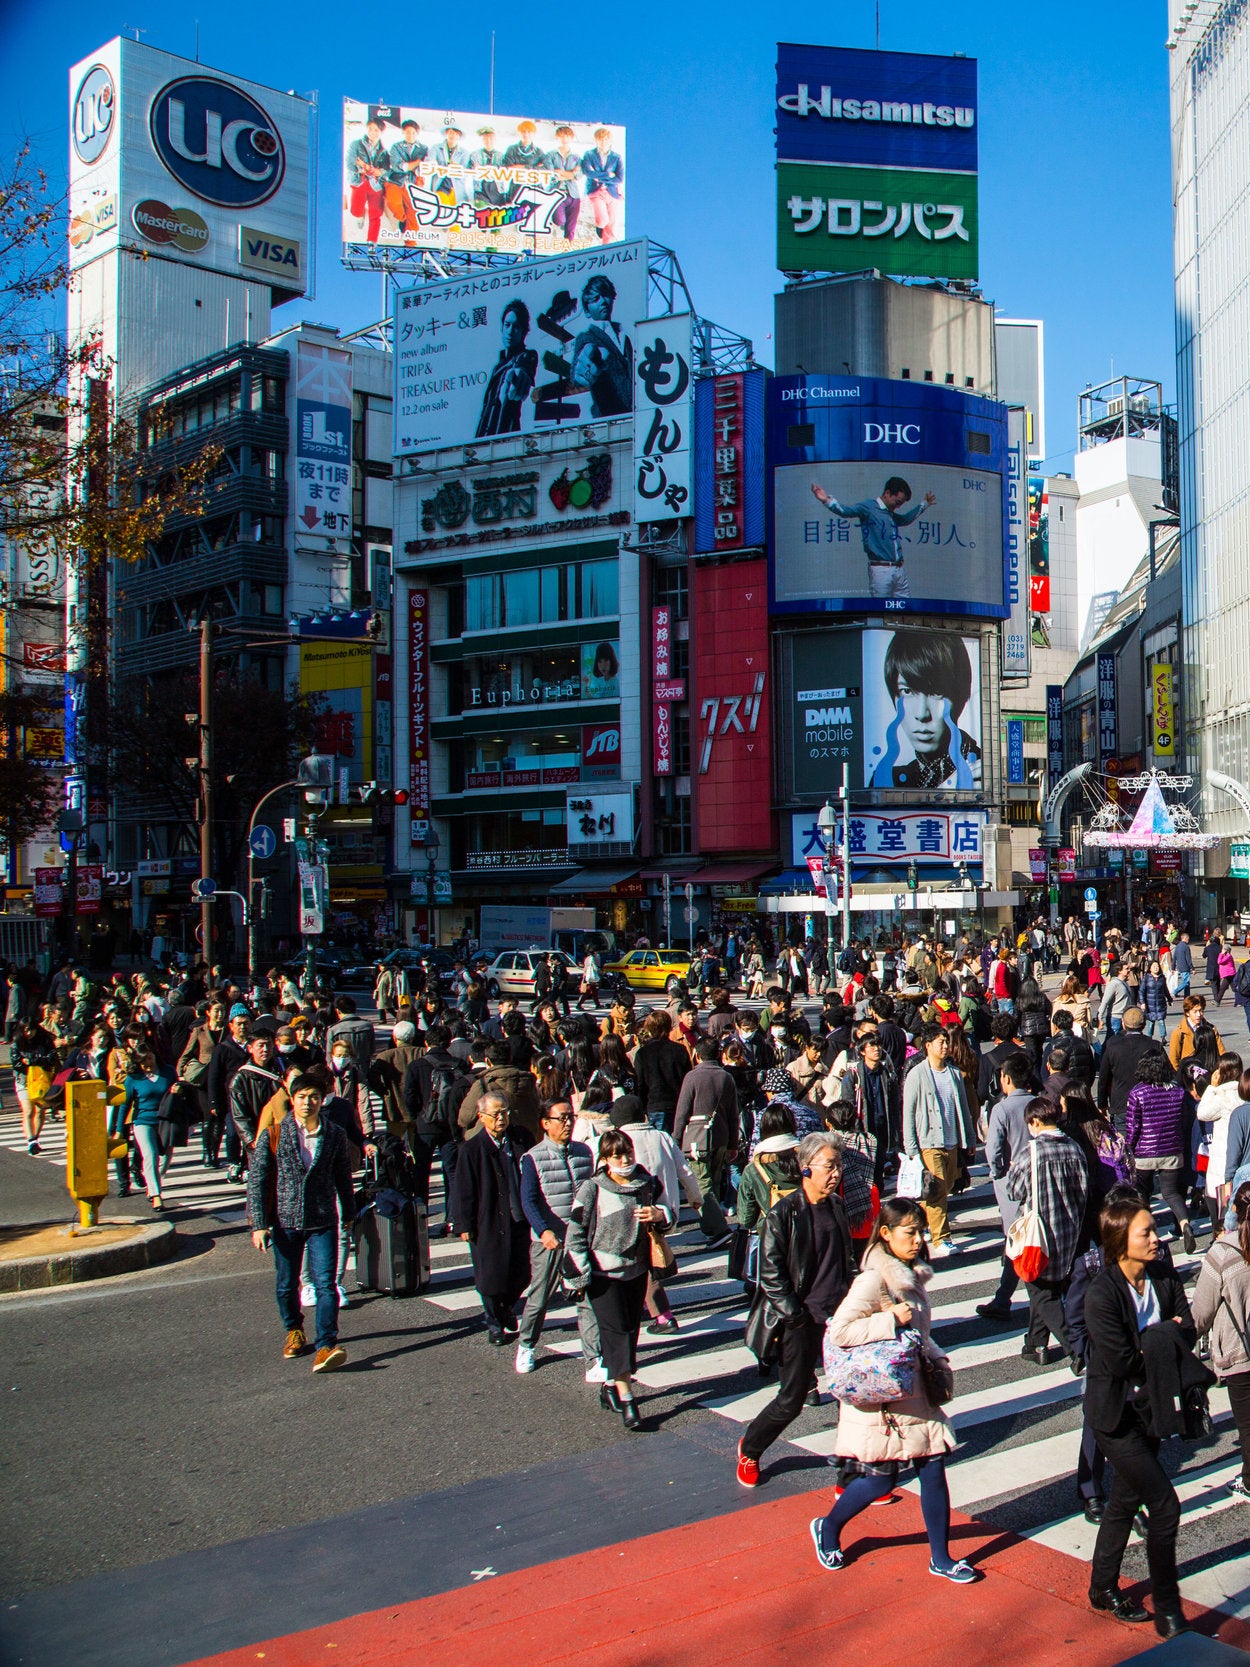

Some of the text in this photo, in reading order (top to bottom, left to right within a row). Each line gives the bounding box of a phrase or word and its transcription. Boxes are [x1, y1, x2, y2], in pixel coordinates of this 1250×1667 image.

[778, 83, 974, 128] Hisamitsu
[168, 97, 280, 182] UC
[418, 161, 552, 185] ジャニーズWEST
[95, 203, 115, 224] VISA
[135, 209, 209, 239] MasterCard
[787, 195, 969, 242] サロンパス
[380, 229, 440, 241] 2nd ALBUM
[524, 236, 592, 252] RELEASE
[246, 239, 299, 268] VISA
[402, 248, 640, 311] 豪華アーティストとのコラボレーションアルバム!
[400, 342, 448, 360] new album
[401, 371, 488, 399] TREASURE TWO
[781, 386, 860, 400] DHC Channel
[401, 399, 449, 416] 12.2 on sale
[302, 412, 313, 440] BOOK
[636, 337, 690, 514] もんじゃ
[863, 422, 921, 445] DHC
[714, 379, 738, 540] 三千里薬品
[298, 461, 350, 486] 夜11時
[962, 478, 986, 491] DHC
[308, 483, 341, 503] まで
[323, 510, 350, 532] 地下
[803, 519, 976, 549] 目指すは、別人。
[885, 600, 906, 609] DHC
[656, 611, 669, 677] お好み焼
[1006, 643, 1025, 651] 3719
[1007, 635, 1024, 643] (03)
[304, 648, 347, 662] Matsumoto
[1006, 651, 1025, 659] 2468
[411, 621, 429, 748] ウィンターフルーツギフト
[470, 683, 574, 707] Euphoria
[805, 706, 852, 727] DMM
[1099, 659, 1117, 751] 洋服の青山
[698, 671, 766, 775] クスリ
[805, 726, 853, 743] mobile
[586, 728, 620, 757] JTB
[656, 706, 670, 772] もんじゃ焼
[1157, 734, 1171, 745] 4F
[809, 747, 850, 759] のスマホ
[1010, 724, 1021, 780] 大盛堂商事ビル
[506, 773, 539, 784] 海外旅行
[801, 820, 979, 855] 大盛堂書店
[721, 901, 756, 910] Tax Free
